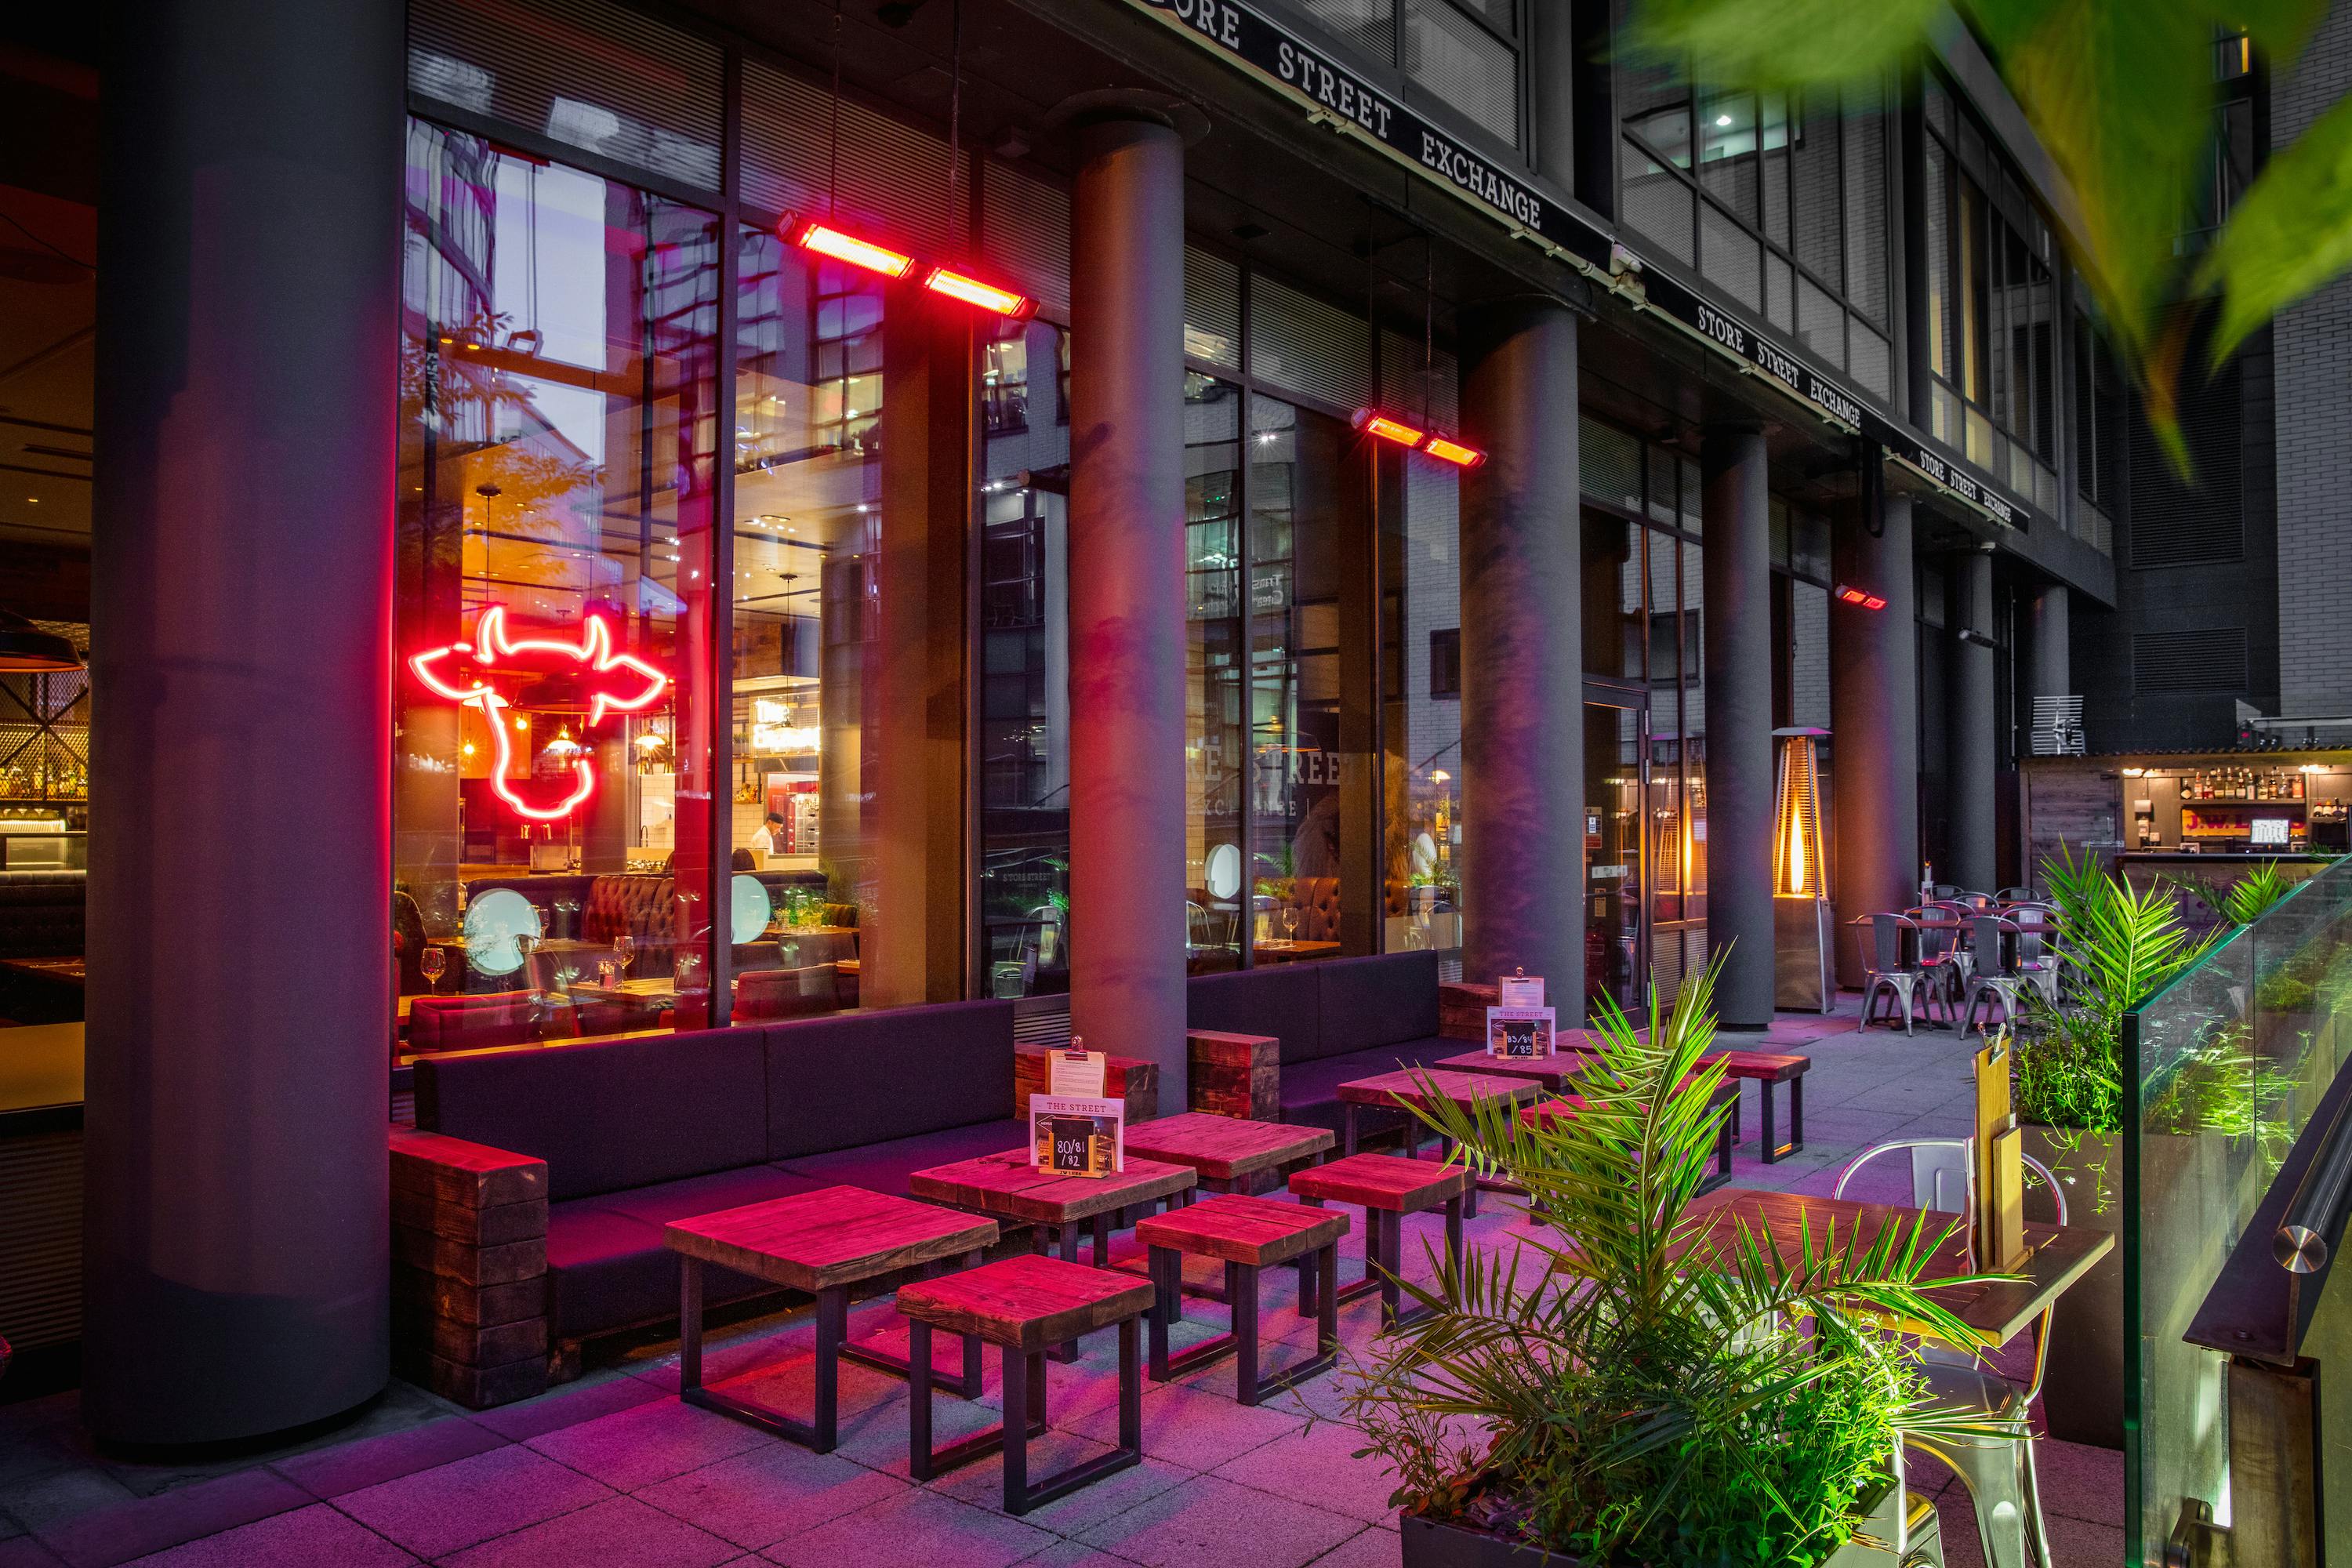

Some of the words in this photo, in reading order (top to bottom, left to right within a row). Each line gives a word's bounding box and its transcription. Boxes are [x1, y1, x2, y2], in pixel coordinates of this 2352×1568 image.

[1151, 0, 1240, 49] ORE
[1279, 42, 1391, 139] STREET
[1421, 131, 1541, 230] EXCHANGE
[1698, 306, 1744, 354] STORE
[1757, 341, 1799, 388] STREET
[1810, 378, 1860, 428] EXCHANGE
[1920, 450, 1944, 481] STORE
[1950, 470, 1976, 500] STREET
[1982, 491, 2011, 523] EXCHANGE
[1253, 751, 1350, 784] STREE
[1069, 1104, 1106, 1112] STREET
[1057, 1138, 1084, 1154] 80/81
